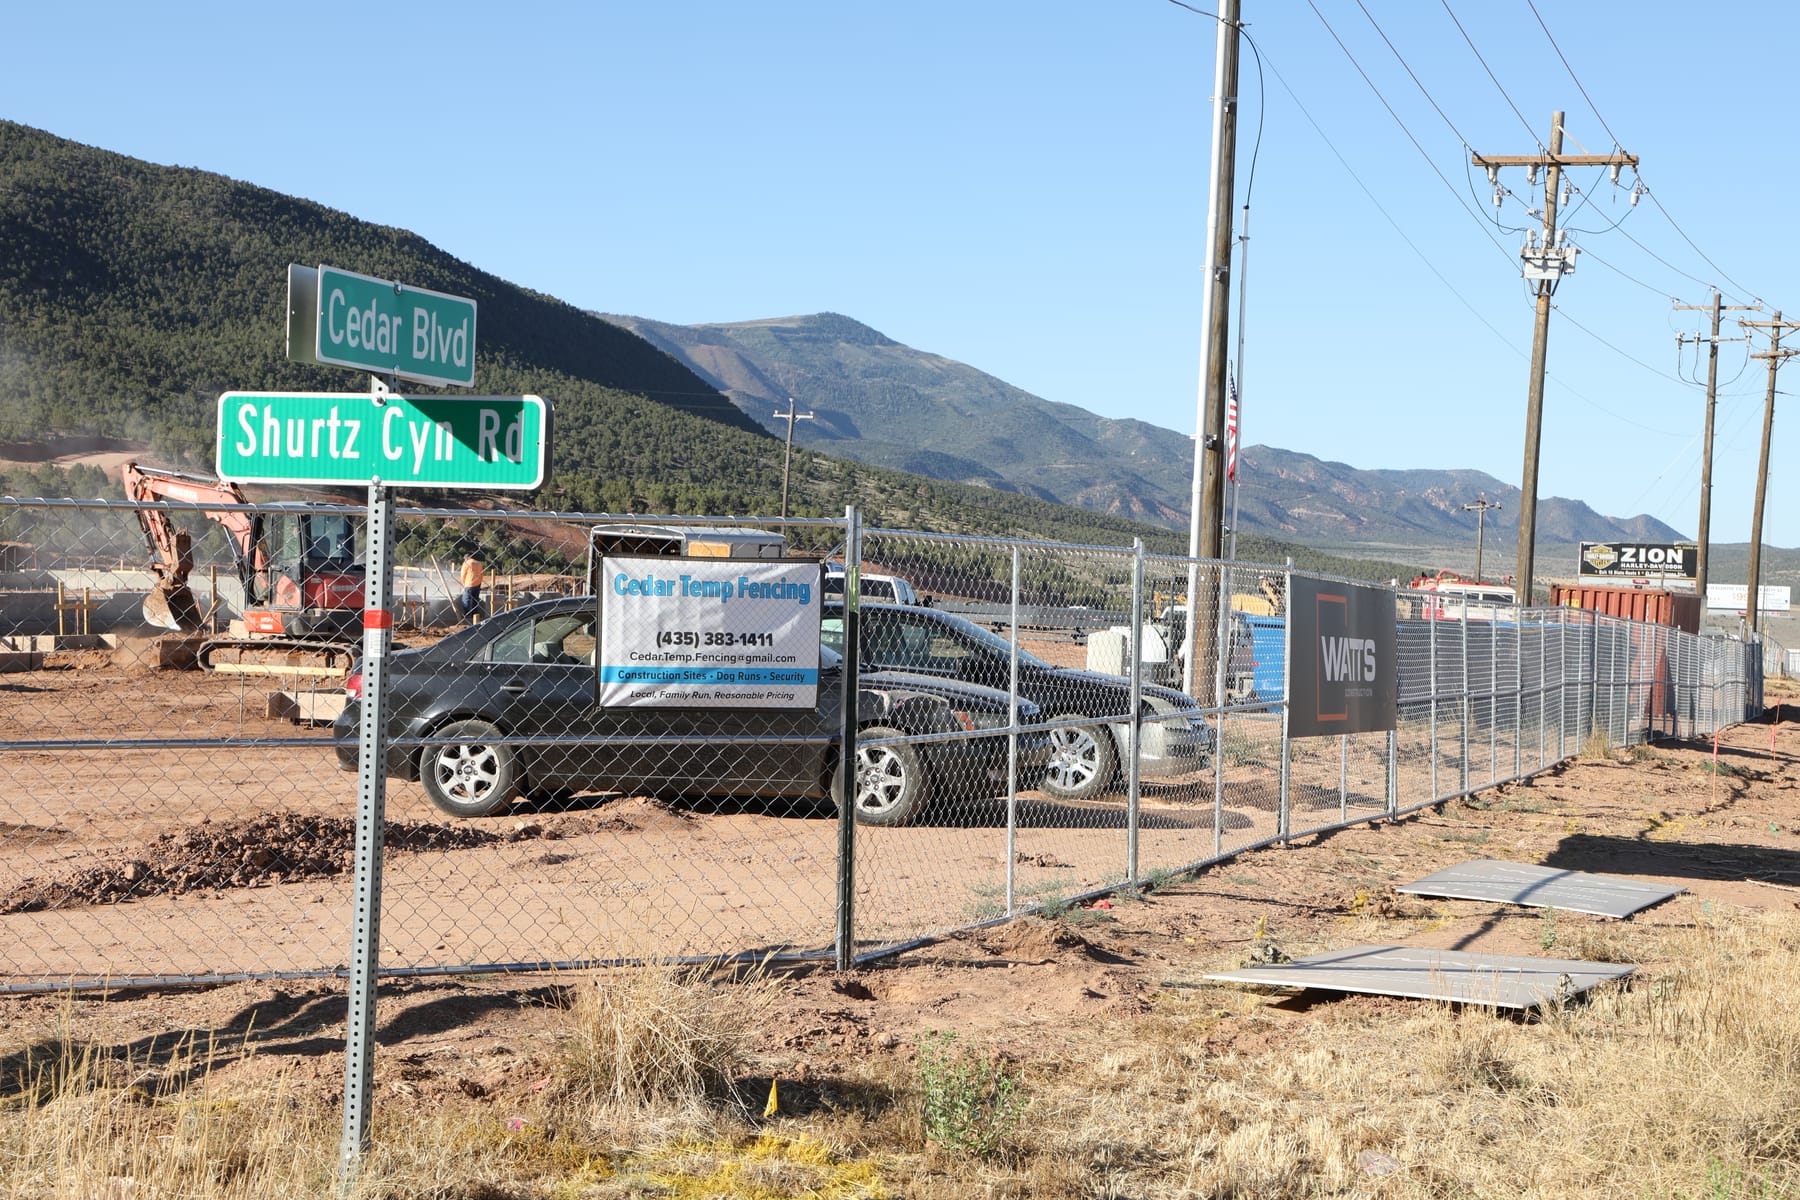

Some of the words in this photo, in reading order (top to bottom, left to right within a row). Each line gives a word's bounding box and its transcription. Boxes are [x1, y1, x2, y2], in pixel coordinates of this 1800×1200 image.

[328, 288, 402, 355] Cedar
[413, 306, 468, 368] Blvd
[236, 403, 361, 459] Shurtz
[382, 405, 454, 475] Cyn
[477, 408, 525, 465] Rd
[1620, 547, 1683, 563] ZION
[1620, 562, 1683, 570] HARLEY-DAVDSON
[614, 573, 676, 597] Cedar
[679, 574, 734, 603] Temp
[737, 576, 811, 605] Fencing
[656, 631, 700, 648] (435)
[704, 632, 773, 647] 383-1411
[629, 651, 796, 664] Cedar.Temp.Fencing@gmail.com
[1321, 635, 1376, 682] WATTS
[618, 670, 681, 680] Construction
[683, 671, 707, 680] Sites
[716, 671, 735, 682] Dog
[738, 672, 761, 681] Runs
[769, 671, 805, 683] Security
[630, 690, 657, 699] Local,
[660, 690, 690, 700] Family
[691, 691, 712, 700] Run,
[714, 691, 765, 700] Reasonable
[766, 691, 795, 701] Pricing
